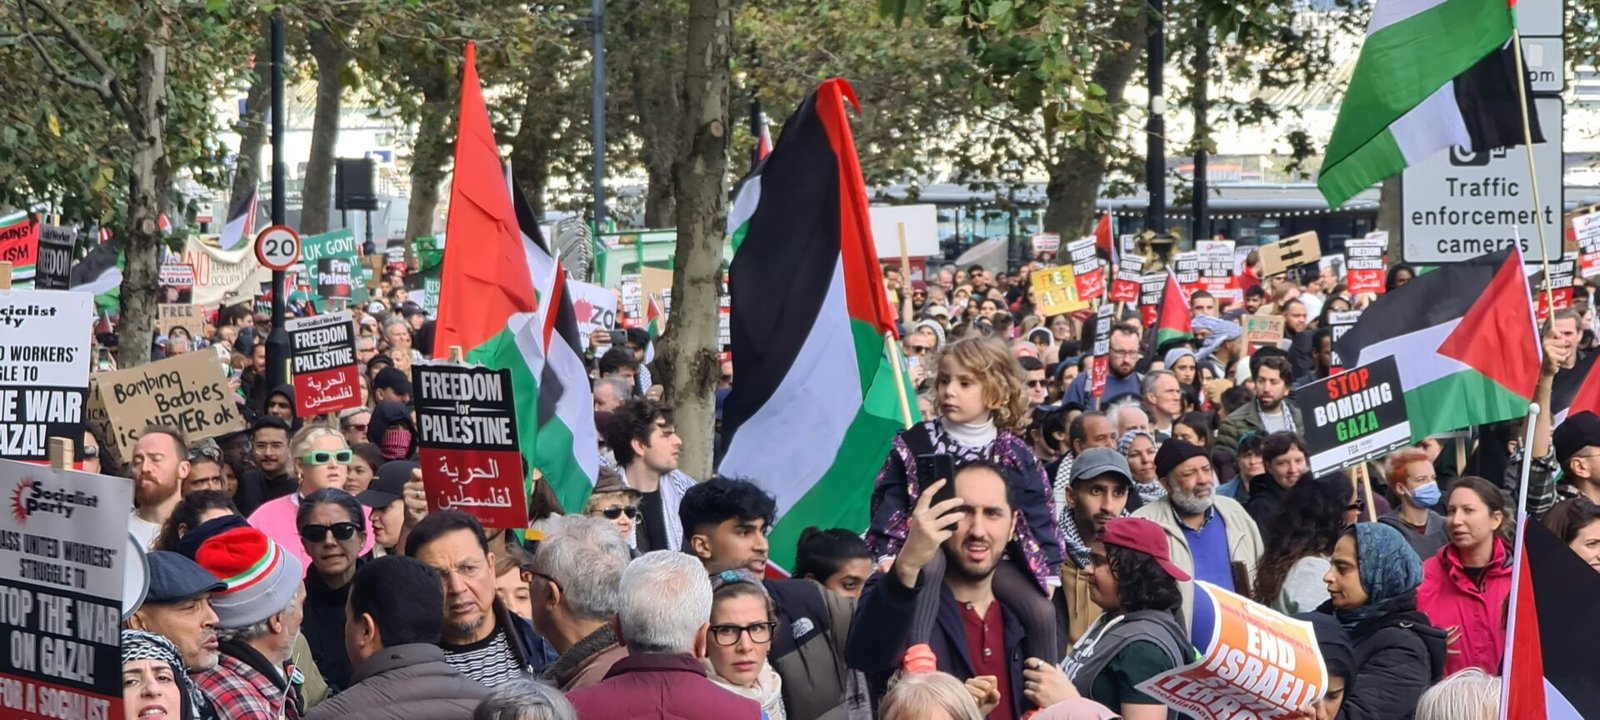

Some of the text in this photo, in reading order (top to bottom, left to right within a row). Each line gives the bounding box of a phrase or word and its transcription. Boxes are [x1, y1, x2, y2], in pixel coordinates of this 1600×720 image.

[1446, 177, 1519, 197] Traffic
[1412, 206, 1553, 224] enforcement
[0, 221, 34, 240] AINST
[265, 239, 295, 257] 20
[304, 244, 322, 260] UK
[326, 237, 354, 255] GOVT
[1437, 237, 1528, 253] cameras
[186, 251, 210, 287] NO
[163, 306, 192, 317] FREE
[296, 315, 342, 328] Socialist Worker
[294, 325, 348, 349] FREEDOM
[295, 347, 354, 372] PALESTINE
[24, 366, 38, 381] TO
[307, 372, 346, 391] الحرية
[420, 371, 503, 402] FREEDOM
[1327, 368, 1369, 399] STOP
[113, 371, 184, 404] Bombing
[154, 381, 224, 413] Babies
[305, 386, 353, 408] لفلسطين
[26, 390, 82, 423] WAR
[455, 402, 471, 415] for
[1314, 382, 1393, 427] BOMBING
[420, 414, 513, 445] PALESTINE
[1336, 410, 1379, 441] GAZA
[0, 424, 47, 455] AZA!
[439, 456, 499, 485] الحرية
[30, 481, 98, 508] Socialist
[437, 487, 512, 510] لفلسطين
[23, 533, 59, 558] UNITED
[20, 558, 71, 586] STRUGGLE
[36, 592, 73, 637] THE
[76, 600, 120, 647] WAR
[11, 630, 95, 684] ON GAZA!
[1246, 623, 1296, 672] END
[1205, 643, 1317, 711] ISRAELI
[0, 677, 111, 720] FOR A SOCIALIST
